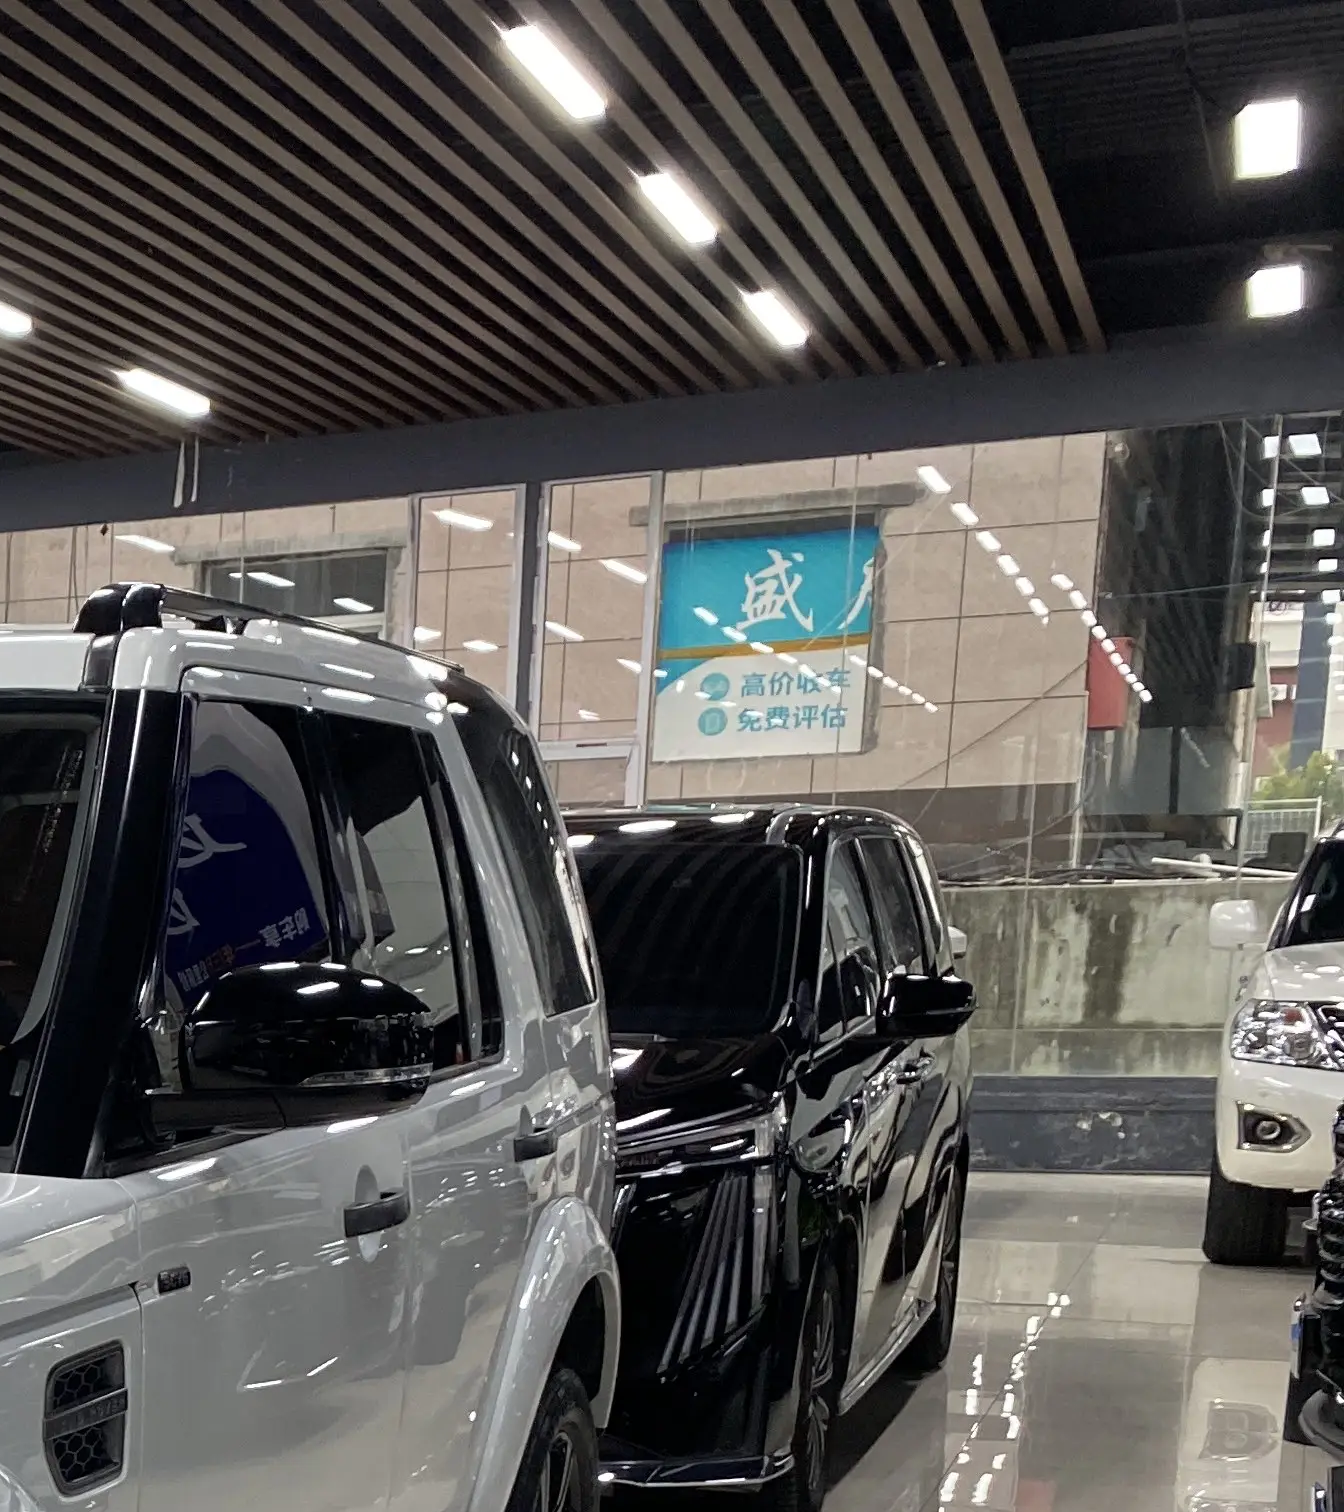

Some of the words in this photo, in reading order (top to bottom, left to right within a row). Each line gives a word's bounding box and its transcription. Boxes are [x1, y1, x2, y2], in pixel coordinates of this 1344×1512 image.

[740, 668, 851, 698] 高价收车
[736, 703, 848, 733] 免费评估
